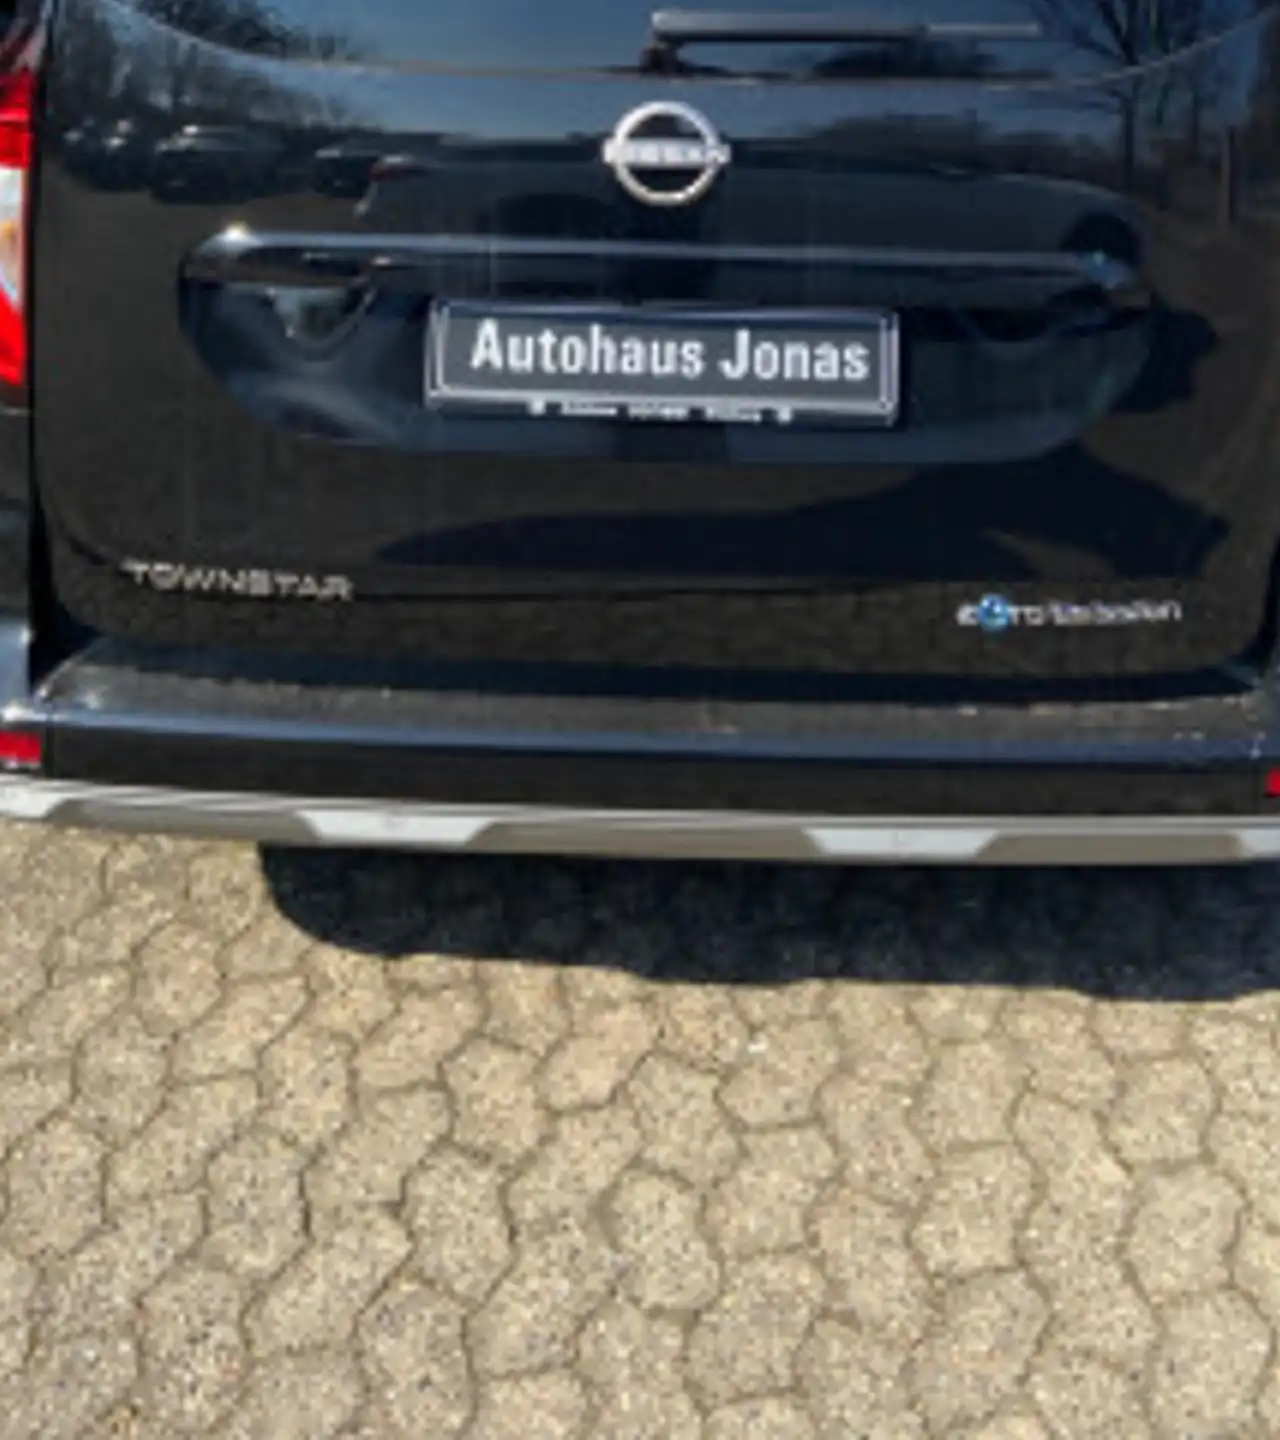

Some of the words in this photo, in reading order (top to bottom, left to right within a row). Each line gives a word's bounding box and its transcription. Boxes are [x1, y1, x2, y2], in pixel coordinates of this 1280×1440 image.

[470, 317, 705, 377] Autohaus
[719, 328, 870, 381] Jonas
[121, 558, 355, 601] TOWNSTAR
